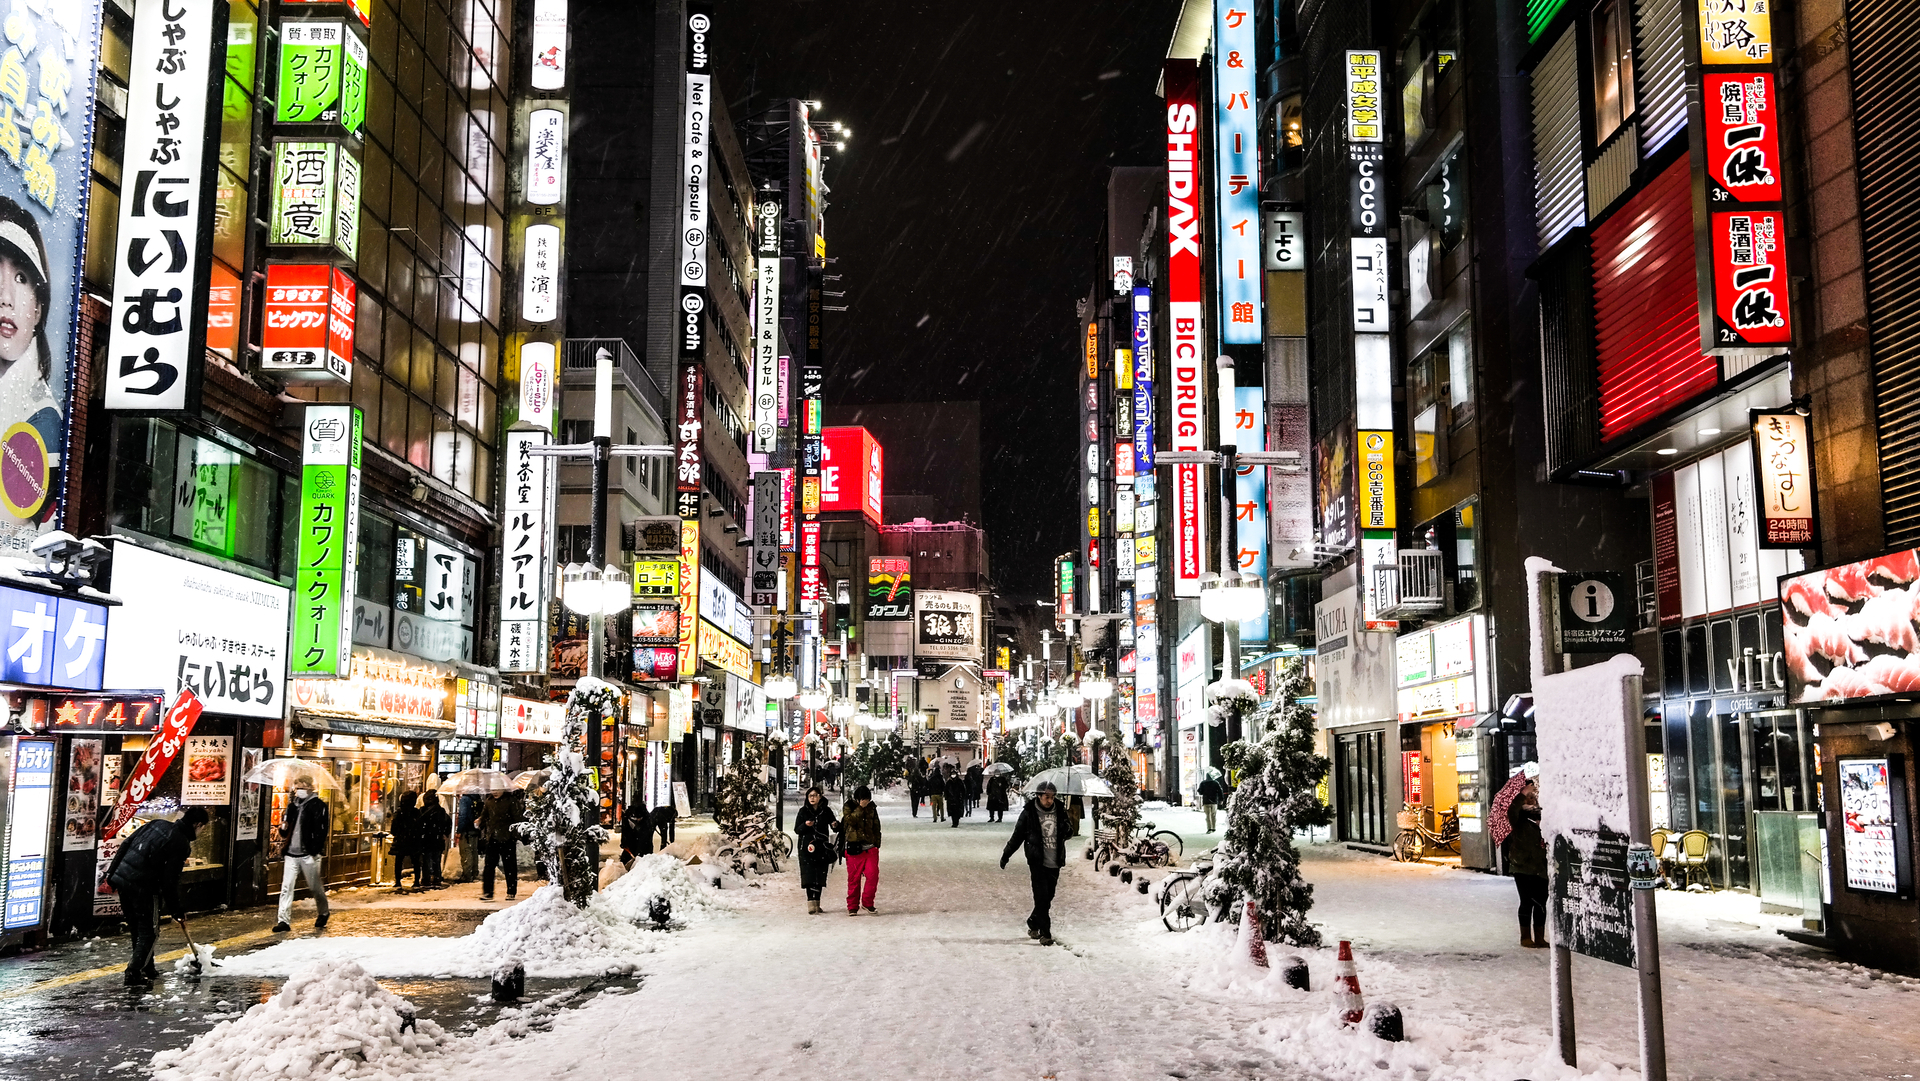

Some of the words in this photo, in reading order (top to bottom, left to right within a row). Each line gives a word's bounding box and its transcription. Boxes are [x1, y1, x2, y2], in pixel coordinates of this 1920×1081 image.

[689, 13, 710, 68] Booth
[1747, 45, 1768, 57] 4F
[692, 83, 704, 106] Net
[1722, 84, 1742, 122] 焼鳥
[322, 111, 337, 120] 5F
[691, 111, 703, 145] Cafe
[691, 149, 703, 159] &
[1351, 153, 1383, 161] Space
[689, 164, 702, 221] Capsule
[1168, 103, 1199, 258] SHIDAX
[1712, 188, 1728, 201] 3F
[762, 201, 779, 251] Booth
[1731, 217, 1752, 264] 居酒屋
[764, 265, 774, 325] ネットカフェ
[682, 293, 704, 350] Booth
[1175, 317, 1195, 360] BIC
[1721, 329, 1737, 342] 2F
[762, 344, 772, 386] カプセル
[1177, 367, 1198, 437] DRUG
[678, 420, 701, 484] 甘太郎
[679, 493, 698, 504] 4F
[679, 506, 698, 518] 3F
[1768, 530, 1812, 542] 年中無休
[1770, 519, 1808, 530] 24時間
[510, 512, 535, 610] ルノアール
[638, 573, 674, 584] ロード
[679, 547, 694, 672] やきとりセンター
[756, 594, 773, 604] B1
[869, 604, 910, 617] カワノ
[7, 602, 105, 680] オケ
[509, 623, 521, 668] 磯丸水産
[177, 655, 274, 706] にいむら
[1730, 699, 1753, 711] COFFEE
[18, 747, 52, 769] カラオケ
